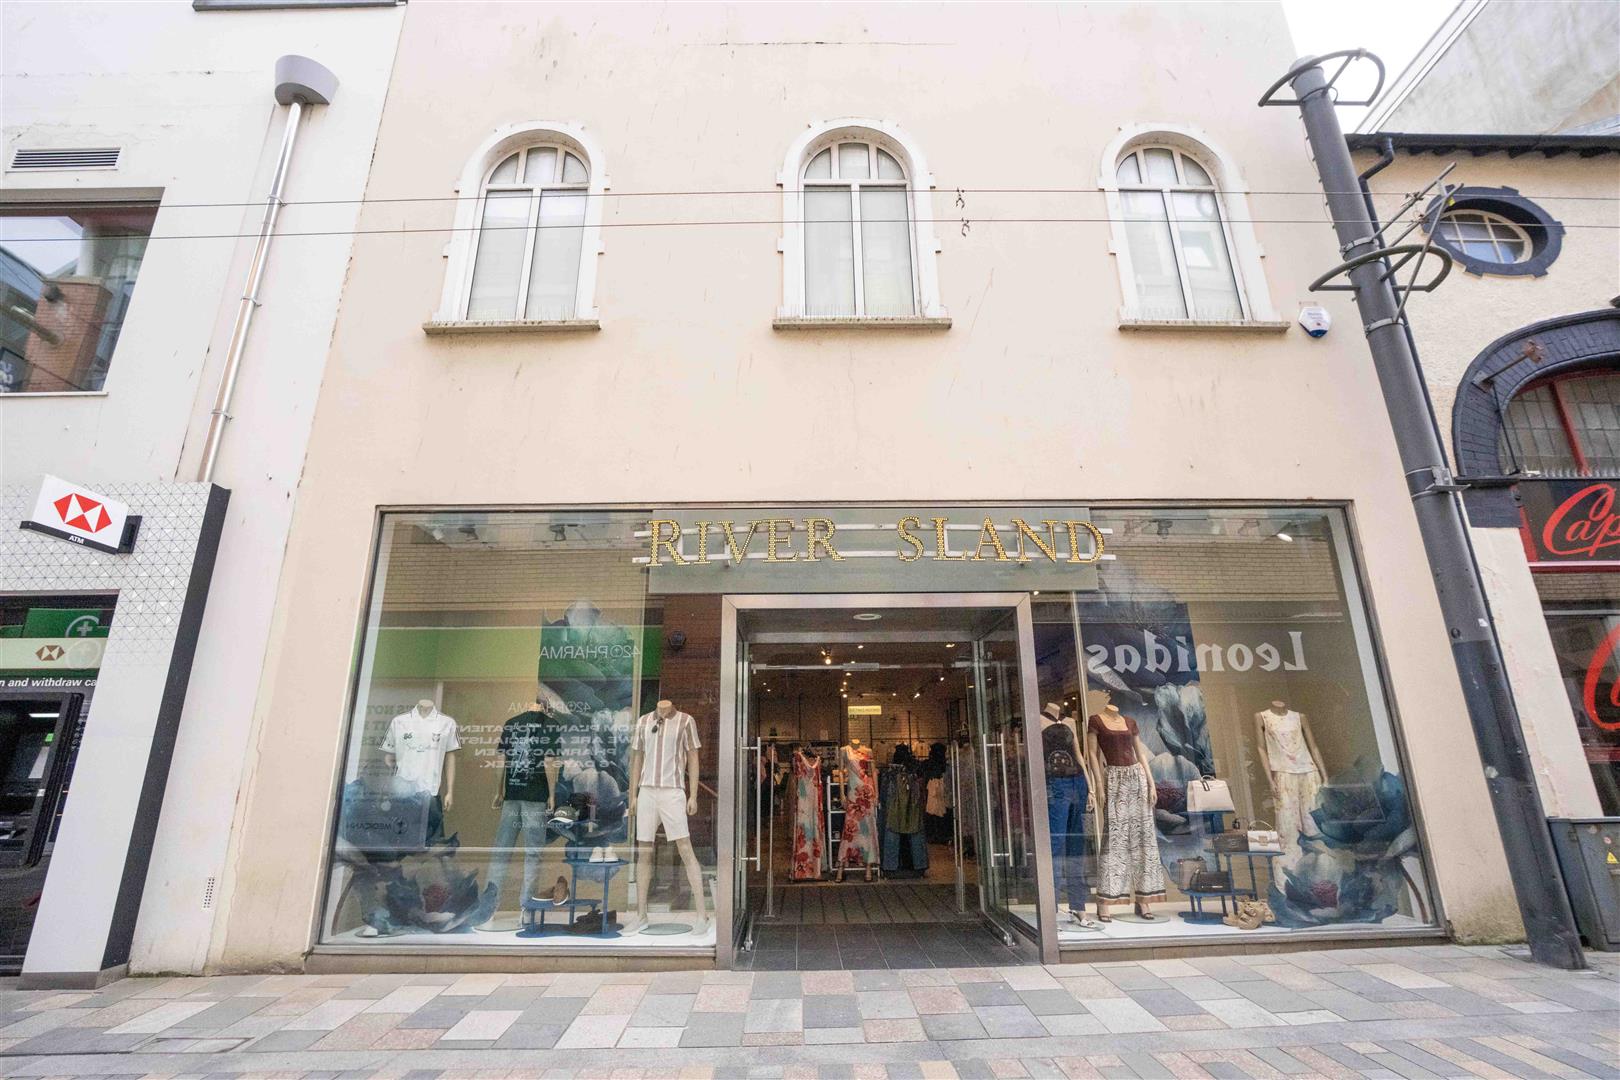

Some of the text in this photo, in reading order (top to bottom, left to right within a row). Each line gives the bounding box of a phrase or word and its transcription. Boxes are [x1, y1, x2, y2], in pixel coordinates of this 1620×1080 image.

[68, 534, 84, 545] ATM
[645, 515, 1105, 567] RIVER SLAND
[8, 677, 29, 687] and
[31, 677, 82, 687] withdraw
